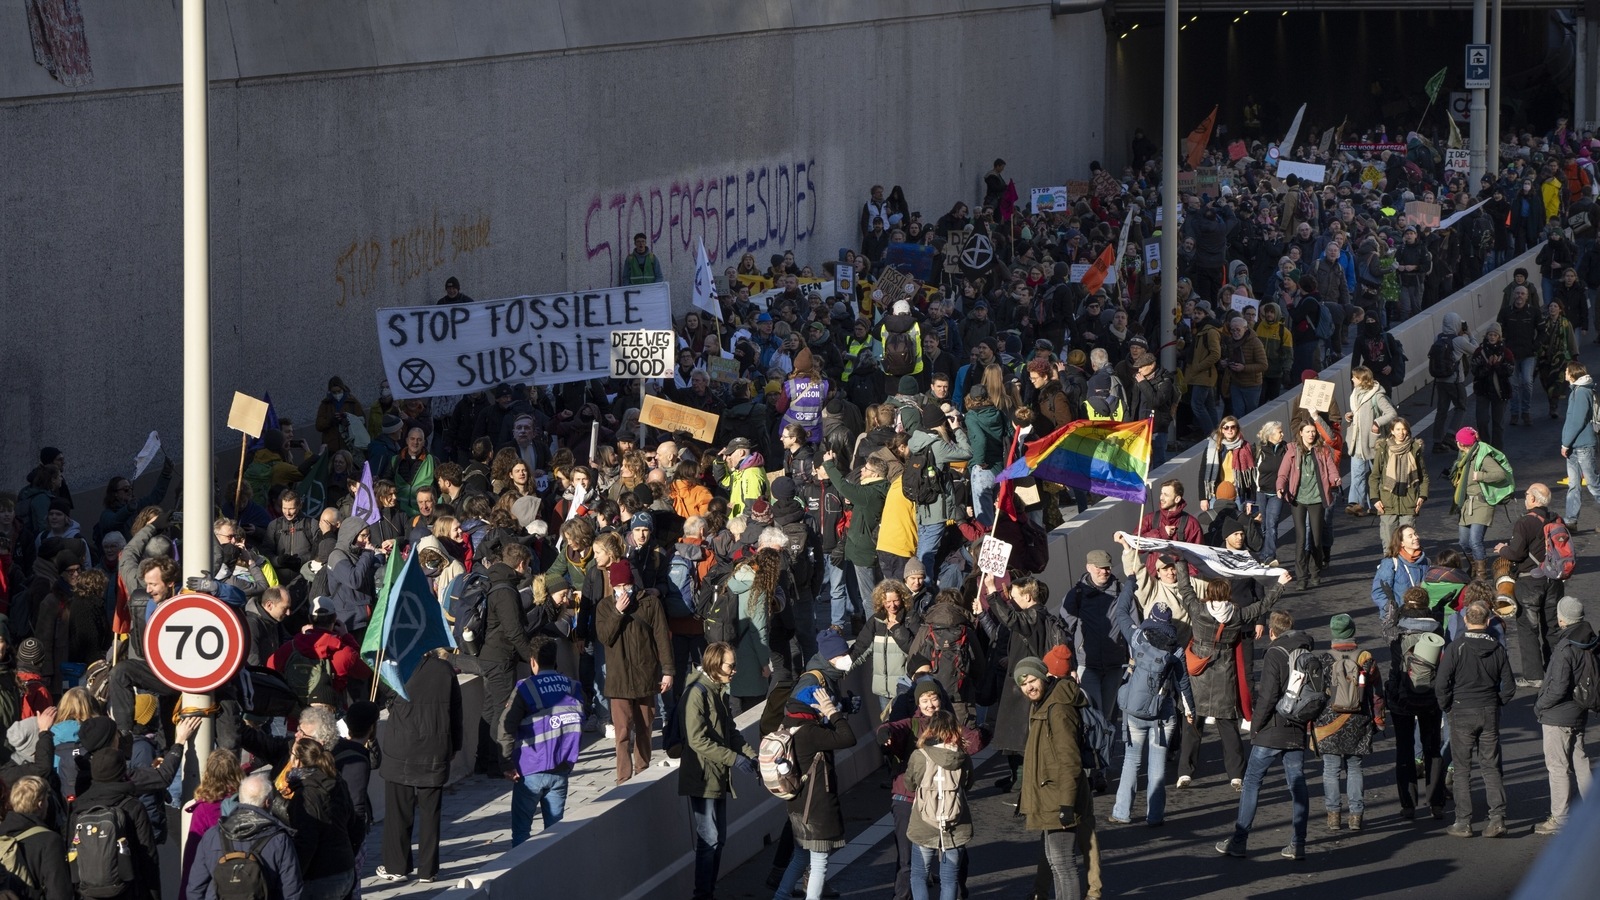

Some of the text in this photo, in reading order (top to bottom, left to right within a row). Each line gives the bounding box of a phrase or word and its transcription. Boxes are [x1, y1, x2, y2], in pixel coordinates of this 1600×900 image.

[1445, 159, 1454, 168] A
[388, 290, 643, 347] STOP FOSSIELE
[612, 332, 670, 347] DEZE WEG
[623, 346, 667, 359] LOOPT
[615, 359, 665, 376] DOOD
[165, 625, 224, 660] 70
[537, 675, 569, 685] POLITIE
[540, 683, 572, 694] LIAISON
